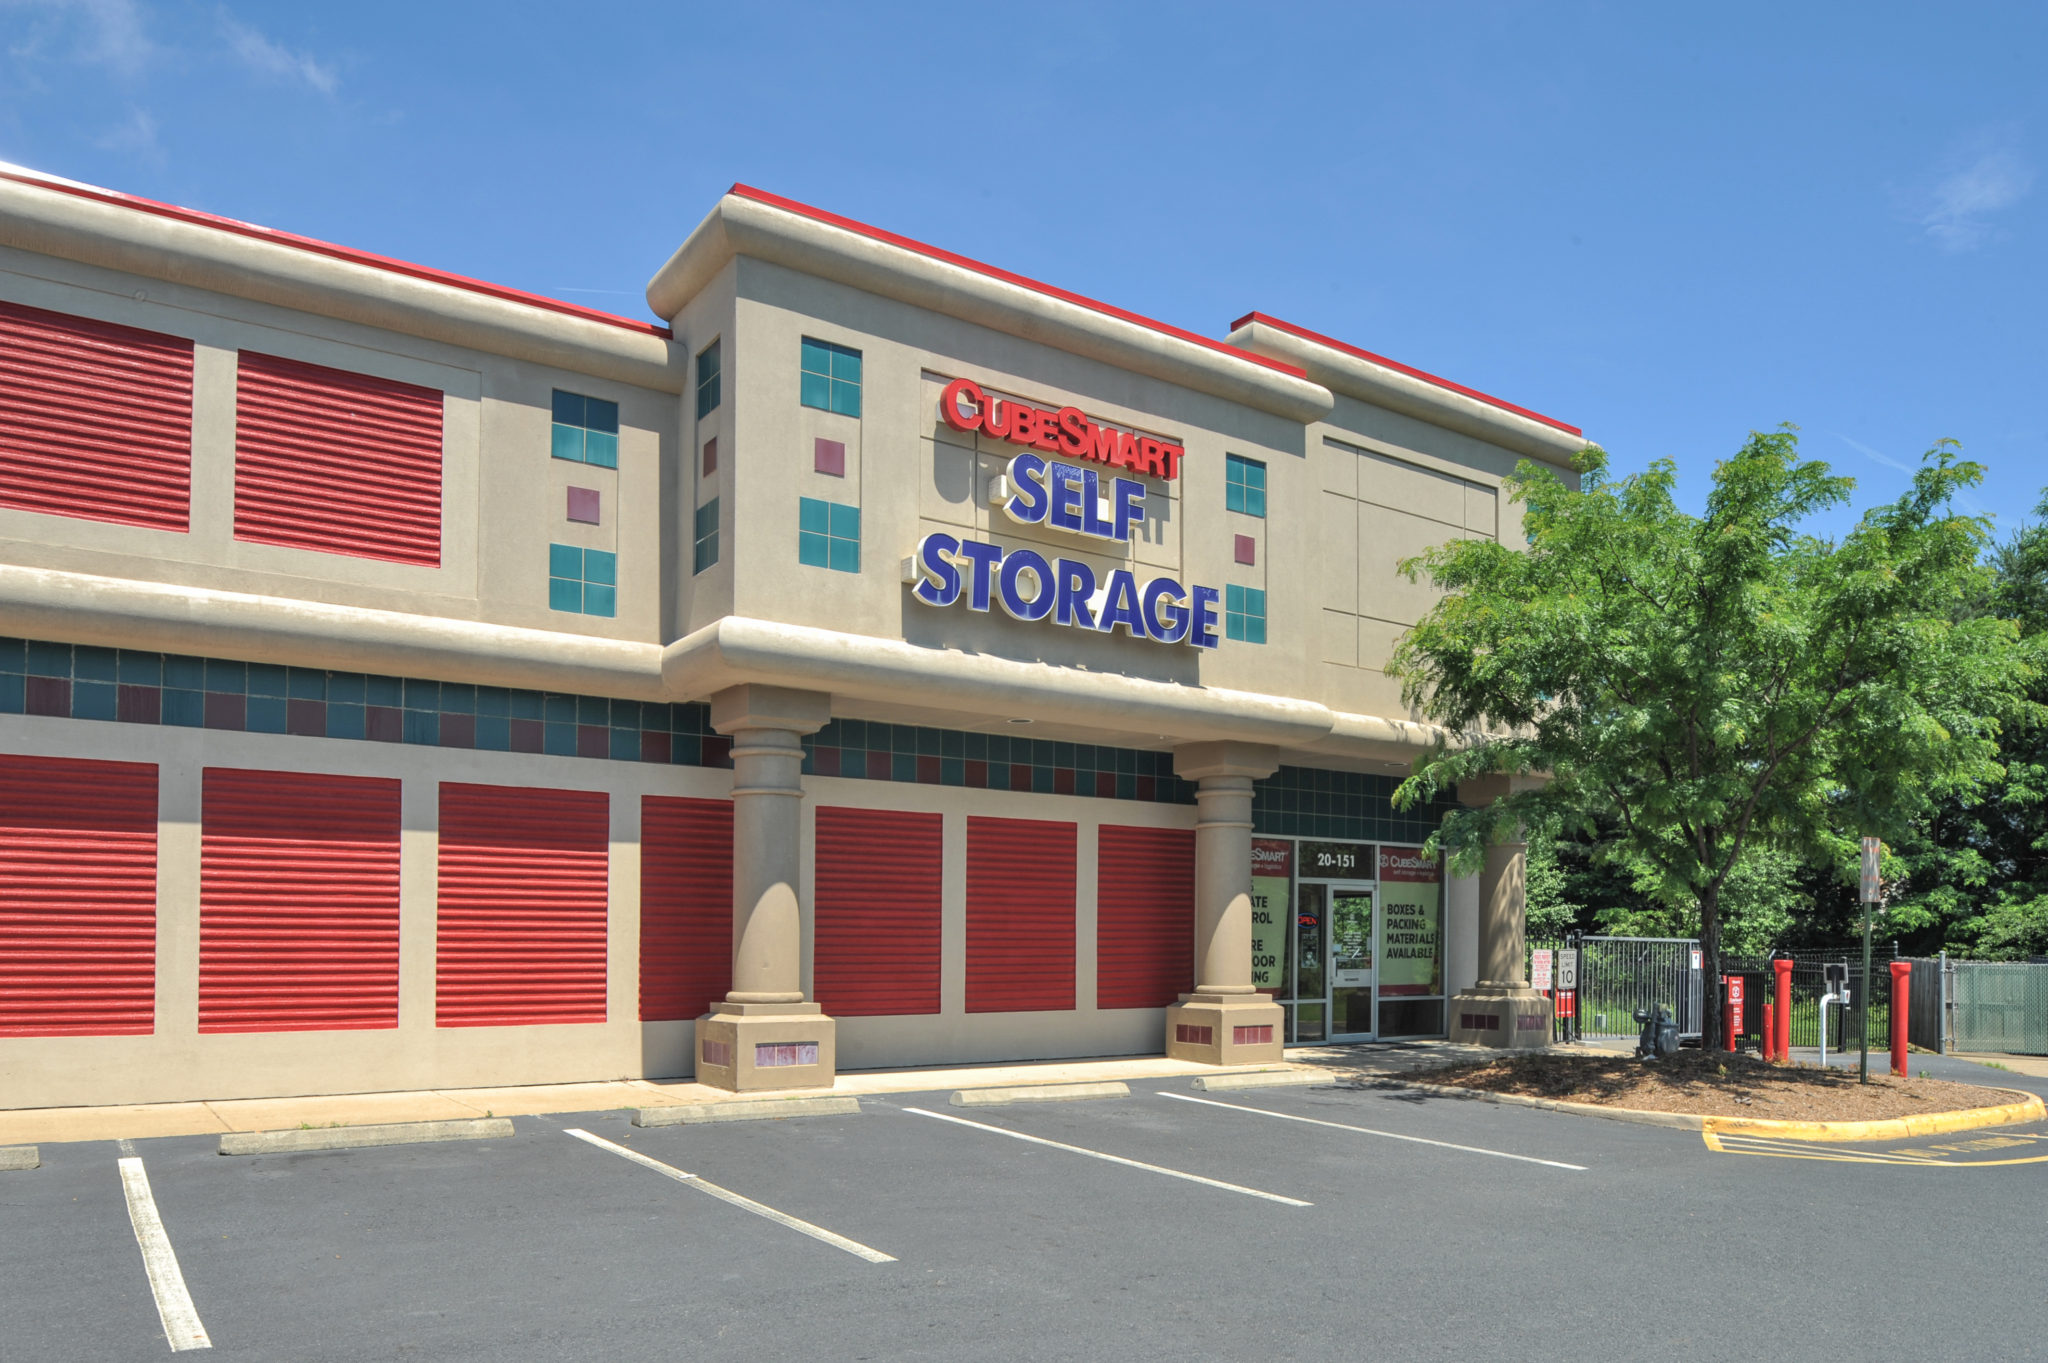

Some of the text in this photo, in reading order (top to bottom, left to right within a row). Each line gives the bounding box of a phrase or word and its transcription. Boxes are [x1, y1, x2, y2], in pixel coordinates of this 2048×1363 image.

[1003, 453, 1147, 543] SELF
[912, 533, 1220, 650] STORAGE
[1251, 847, 1286, 863] ESMART
[1317, 853, 1355, 868] 20-151
[1251, 896, 1268, 908] ATE
[1387, 904, 1425, 915] BOXES &
[1252, 912, 1273, 924] ROL
[1386, 918, 1426, 930] PACKING
[1386, 933, 1434, 944] MATERIALS
[1386, 947, 1433, 959] AVAILABLE
[1252, 955, 1276, 967] OOR
[1252, 971, 1269, 983] ING
[1562, 970, 1573, 983] 10
